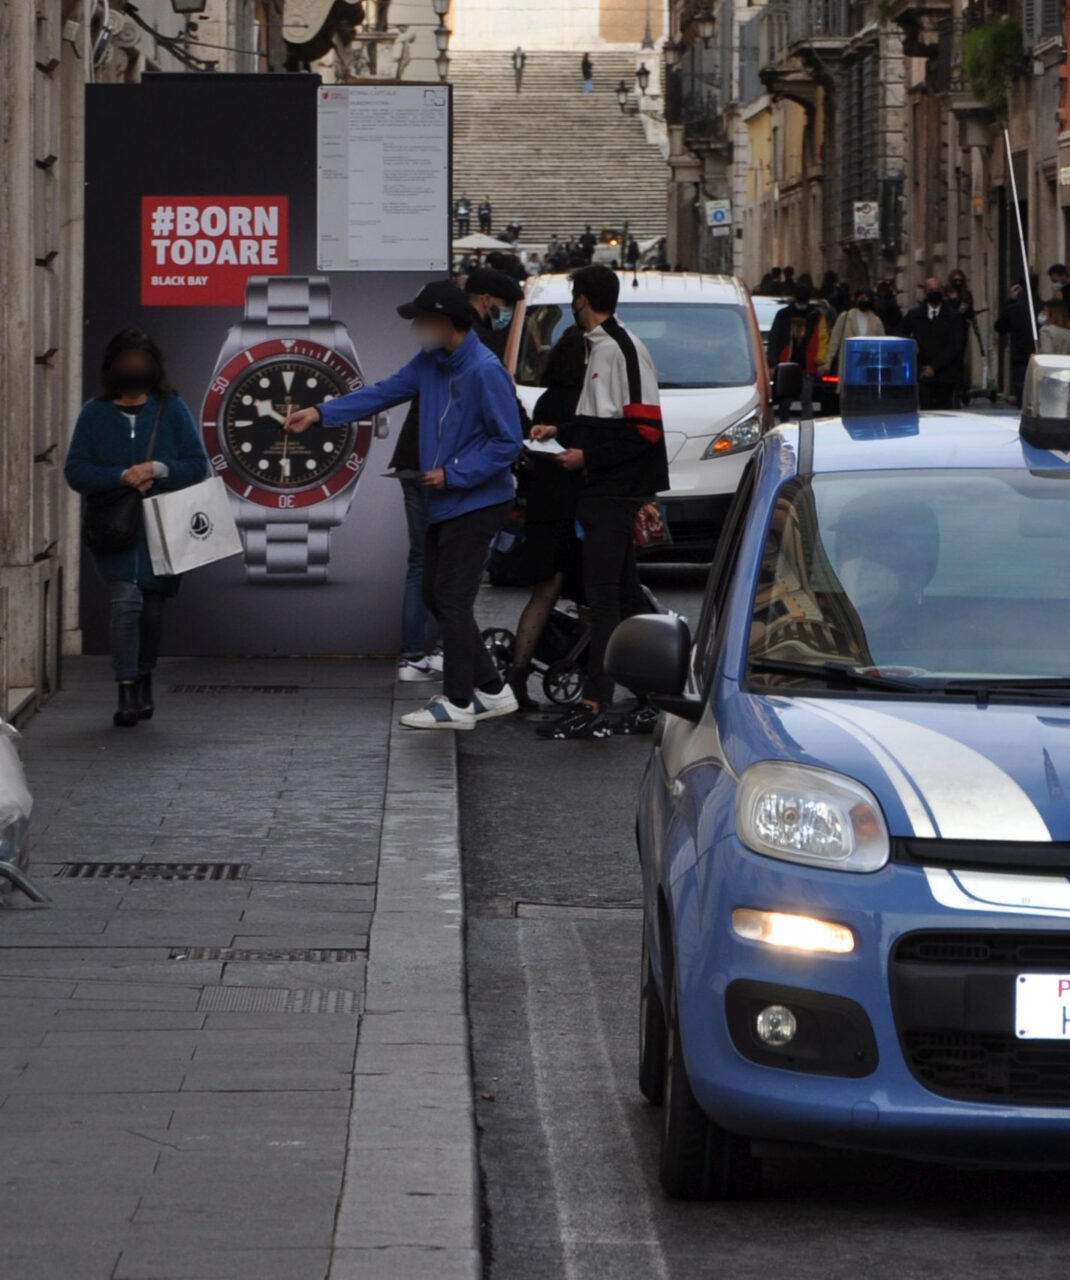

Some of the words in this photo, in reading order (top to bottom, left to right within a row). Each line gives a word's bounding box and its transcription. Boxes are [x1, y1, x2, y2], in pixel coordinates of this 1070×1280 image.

[151, 206, 279, 237] #BORN
[151, 239, 279, 265] TODARE
[151, 275, 186, 286] BLACK
[187, 275, 208, 286] BAY
[212, 376, 229, 395] 50
[346, 453, 364, 472] 20
[277, 494, 296, 508] 30
